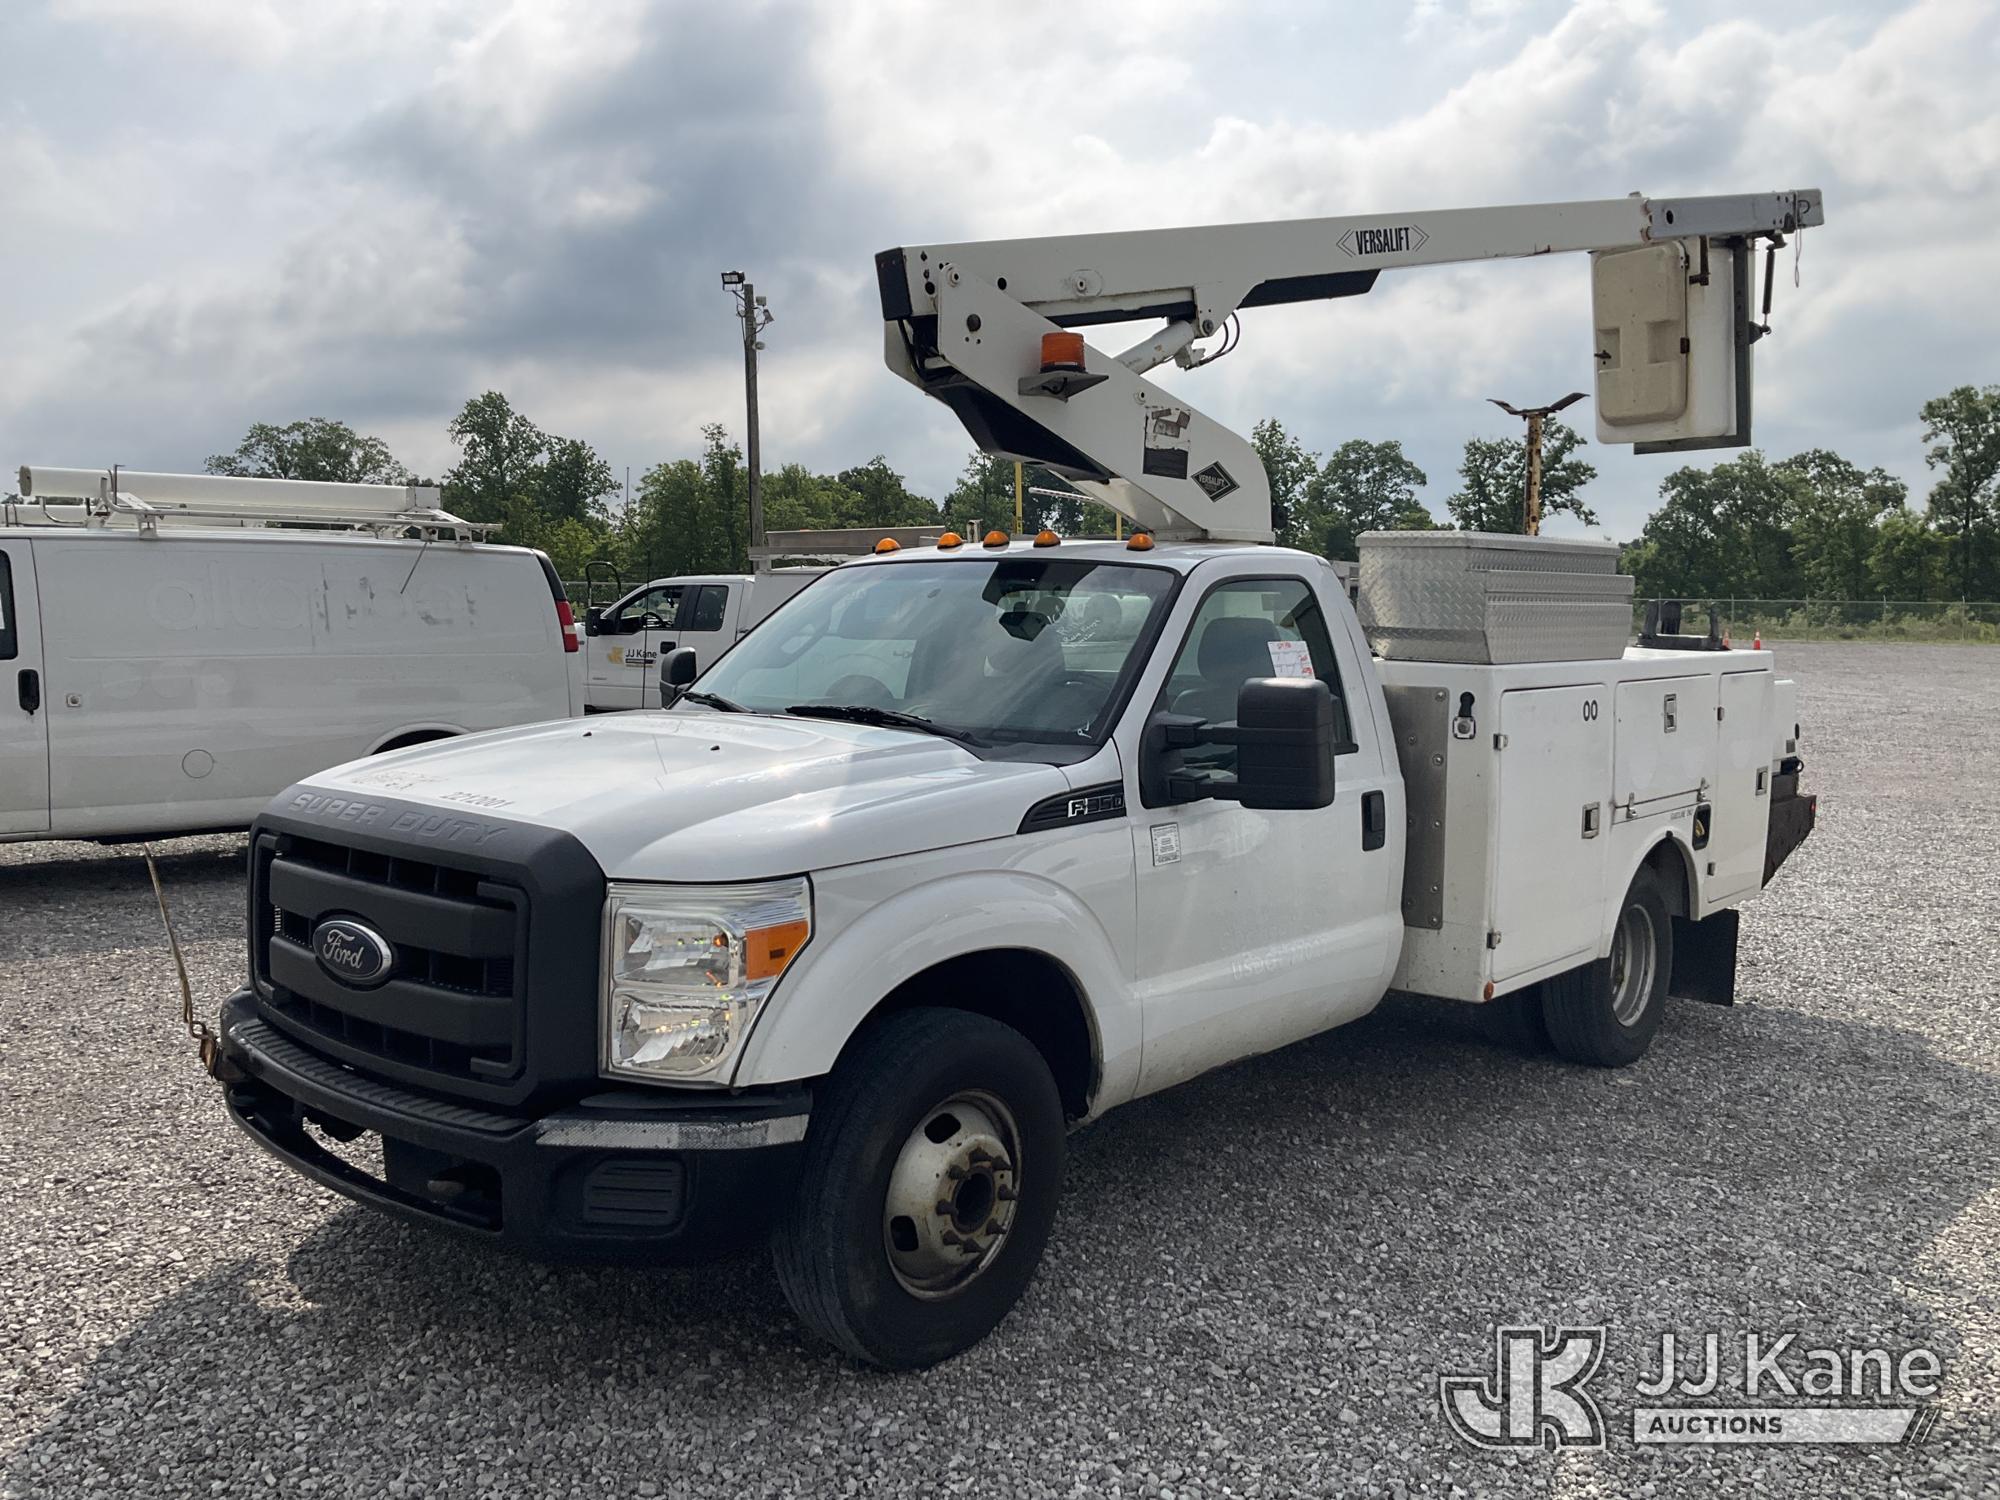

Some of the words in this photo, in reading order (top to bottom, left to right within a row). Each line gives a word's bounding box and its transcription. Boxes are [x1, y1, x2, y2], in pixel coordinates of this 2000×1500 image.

[1356, 227, 1410, 255] VERSALIFT
[625, 648, 635, 658] JJ
[288, 793, 386, 825] SUPER
[390, 810, 508, 846] DUTY
[323, 929, 364, 969] Ford
